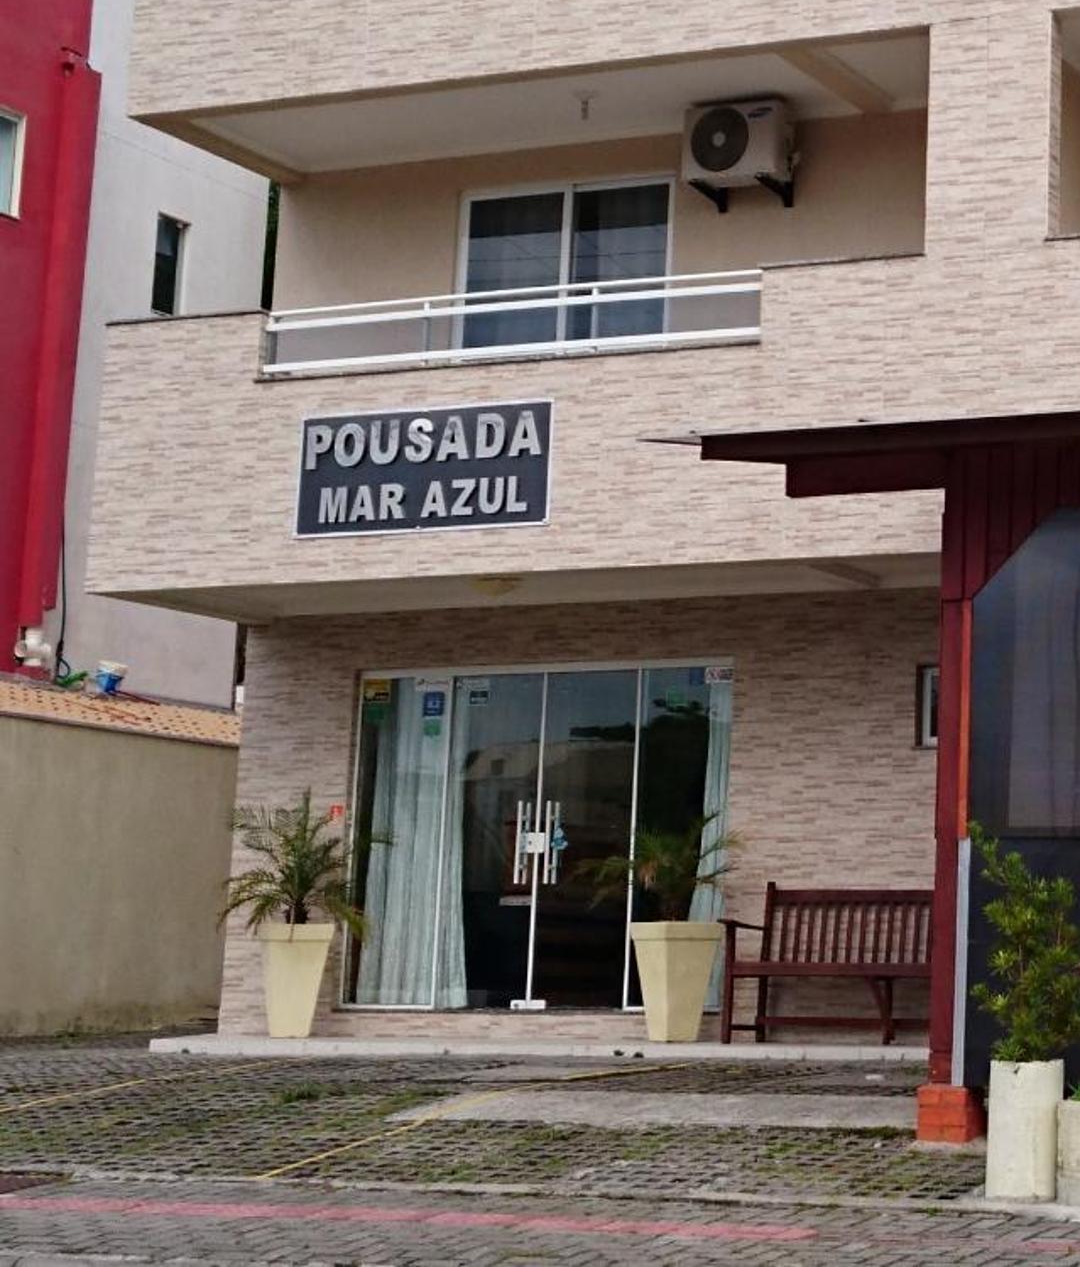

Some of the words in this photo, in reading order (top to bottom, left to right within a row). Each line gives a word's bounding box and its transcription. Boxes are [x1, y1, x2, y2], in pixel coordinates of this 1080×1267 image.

[304, 410, 542, 470] POUSADA
[318, 482, 406, 524] MAR
[420, 475, 528, 518] AZUL
